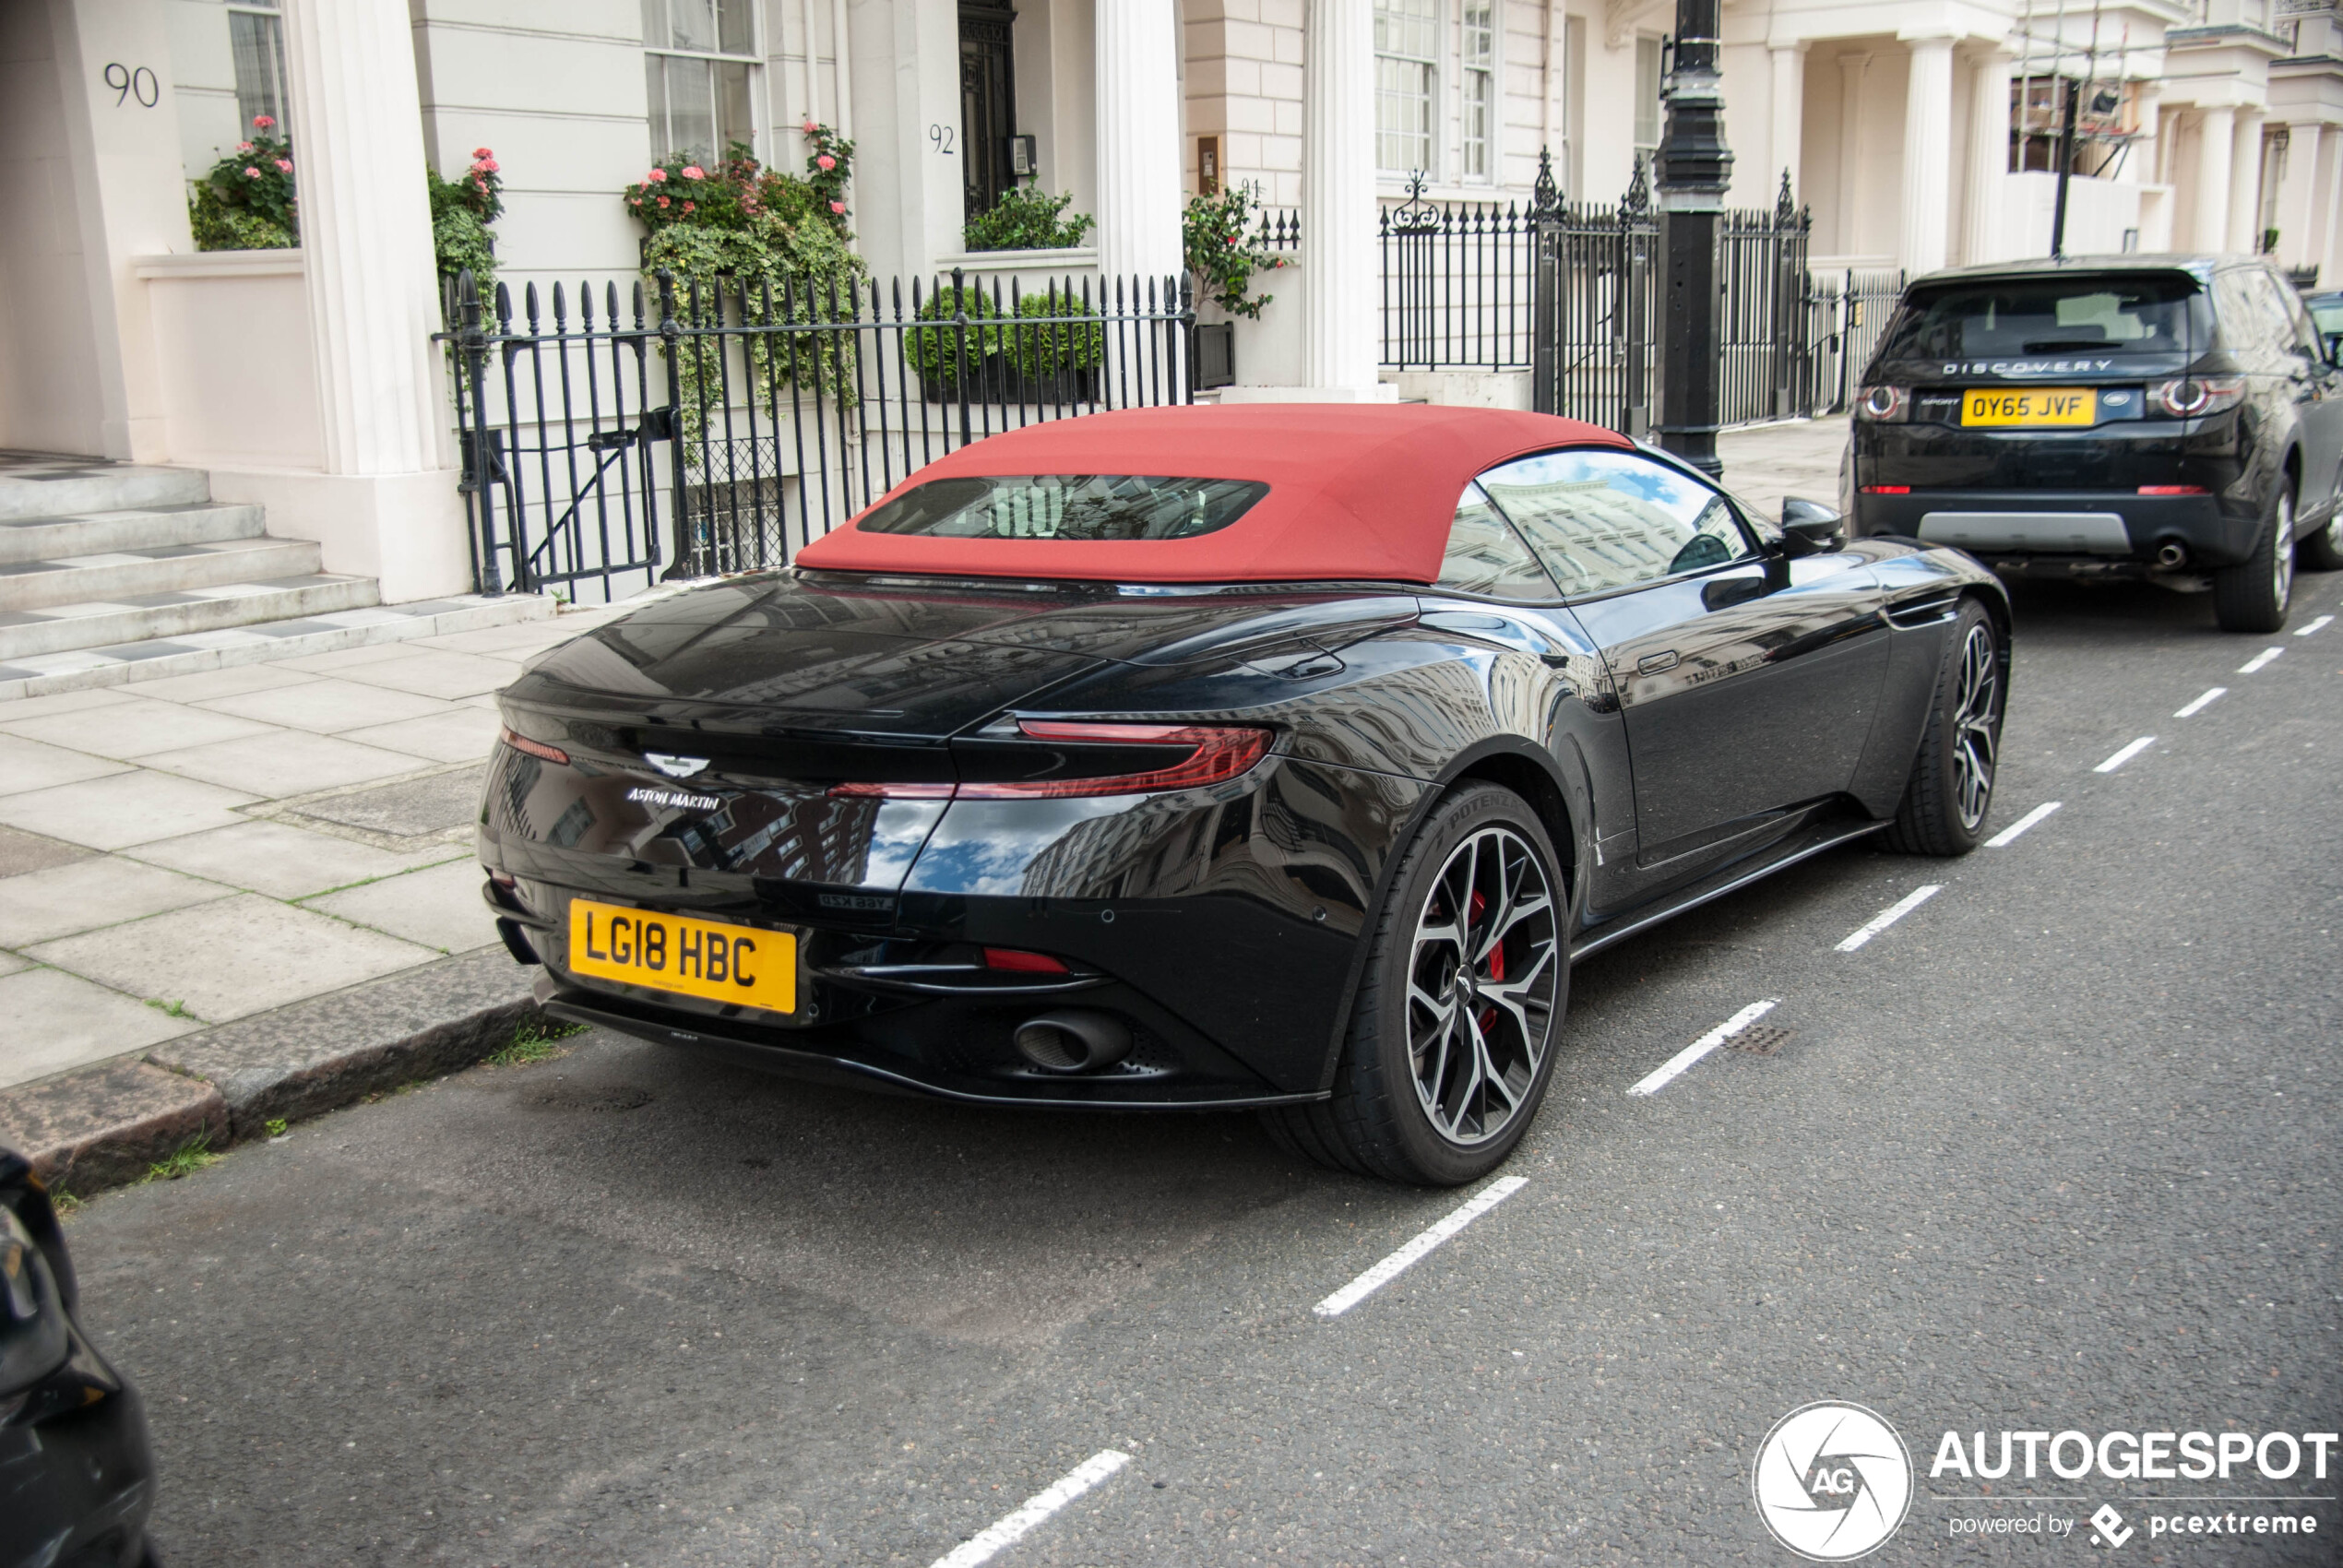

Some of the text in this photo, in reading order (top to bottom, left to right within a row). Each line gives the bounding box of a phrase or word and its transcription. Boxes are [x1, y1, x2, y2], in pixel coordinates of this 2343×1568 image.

[104, 63, 160, 109] 90
[930, 123, 955, 155] 92
[1942, 360, 2112, 375] DISCOVERY
[1921, 398, 1961, 406] SPORT
[1973, 397, 2030, 417] OY65
[2037, 396, 2083, 416] JVF
[627, 788, 720, 810] ASTON MARTIN
[587, 910, 757, 987] LG18 HBC
